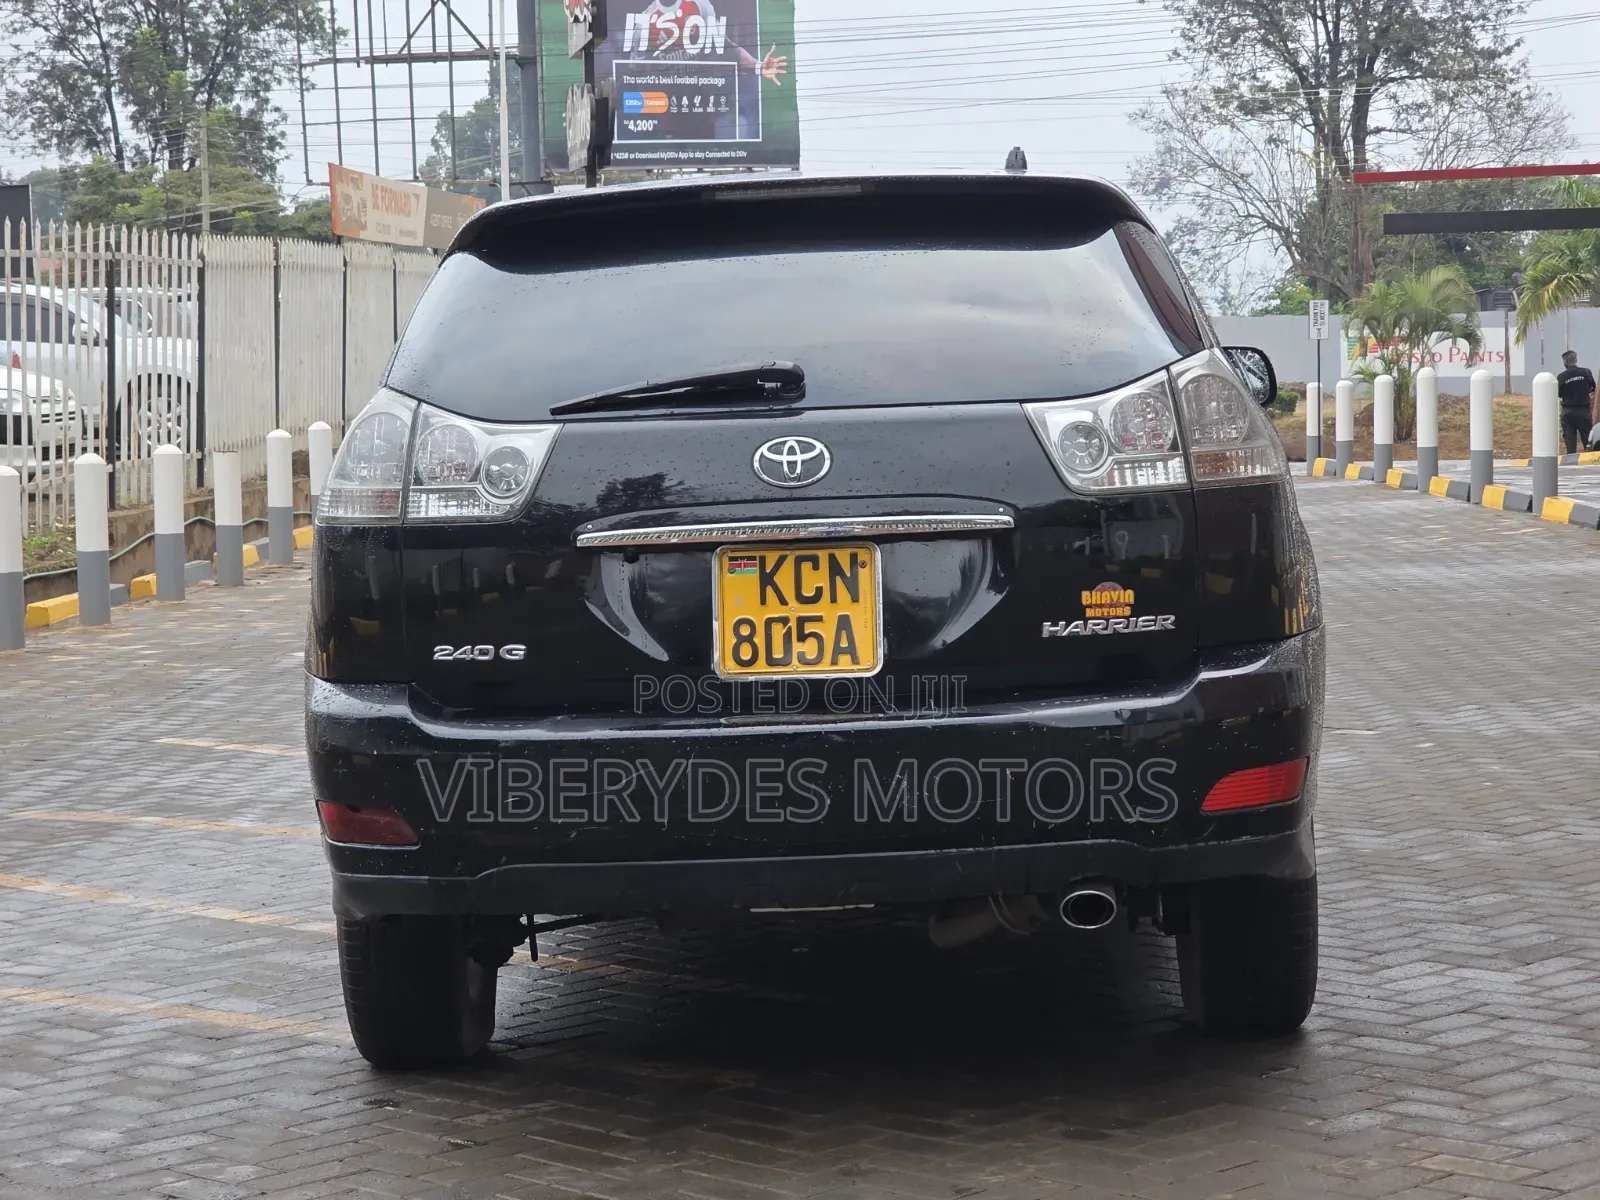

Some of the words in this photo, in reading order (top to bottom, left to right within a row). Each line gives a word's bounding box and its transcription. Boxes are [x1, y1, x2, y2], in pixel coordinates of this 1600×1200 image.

[683, 15, 727, 55] ON
[623, 76, 634, 84] The
[635, 76, 659, 84] world's
[659, 76, 673, 84] best
[674, 76, 698, 84] football
[698, 77, 726, 87] package
[628, 119, 654, 133] 4,200
[678, 151, 689, 160] App
[694, 151, 705, 160] stay
[730, 150, 736, 158] to
[380, 185, 412, 218] FORWARD
[758, 552, 860, 607] KCN
[1081, 589, 1135, 606] BHAVIN
[1085, 606, 1131, 618] MOTORS
[1042, 614, 1176, 638] HARRIER
[732, 613, 861, 668] 805A
[433, 644, 494, 661] 240
[499, 643, 527, 660] G
